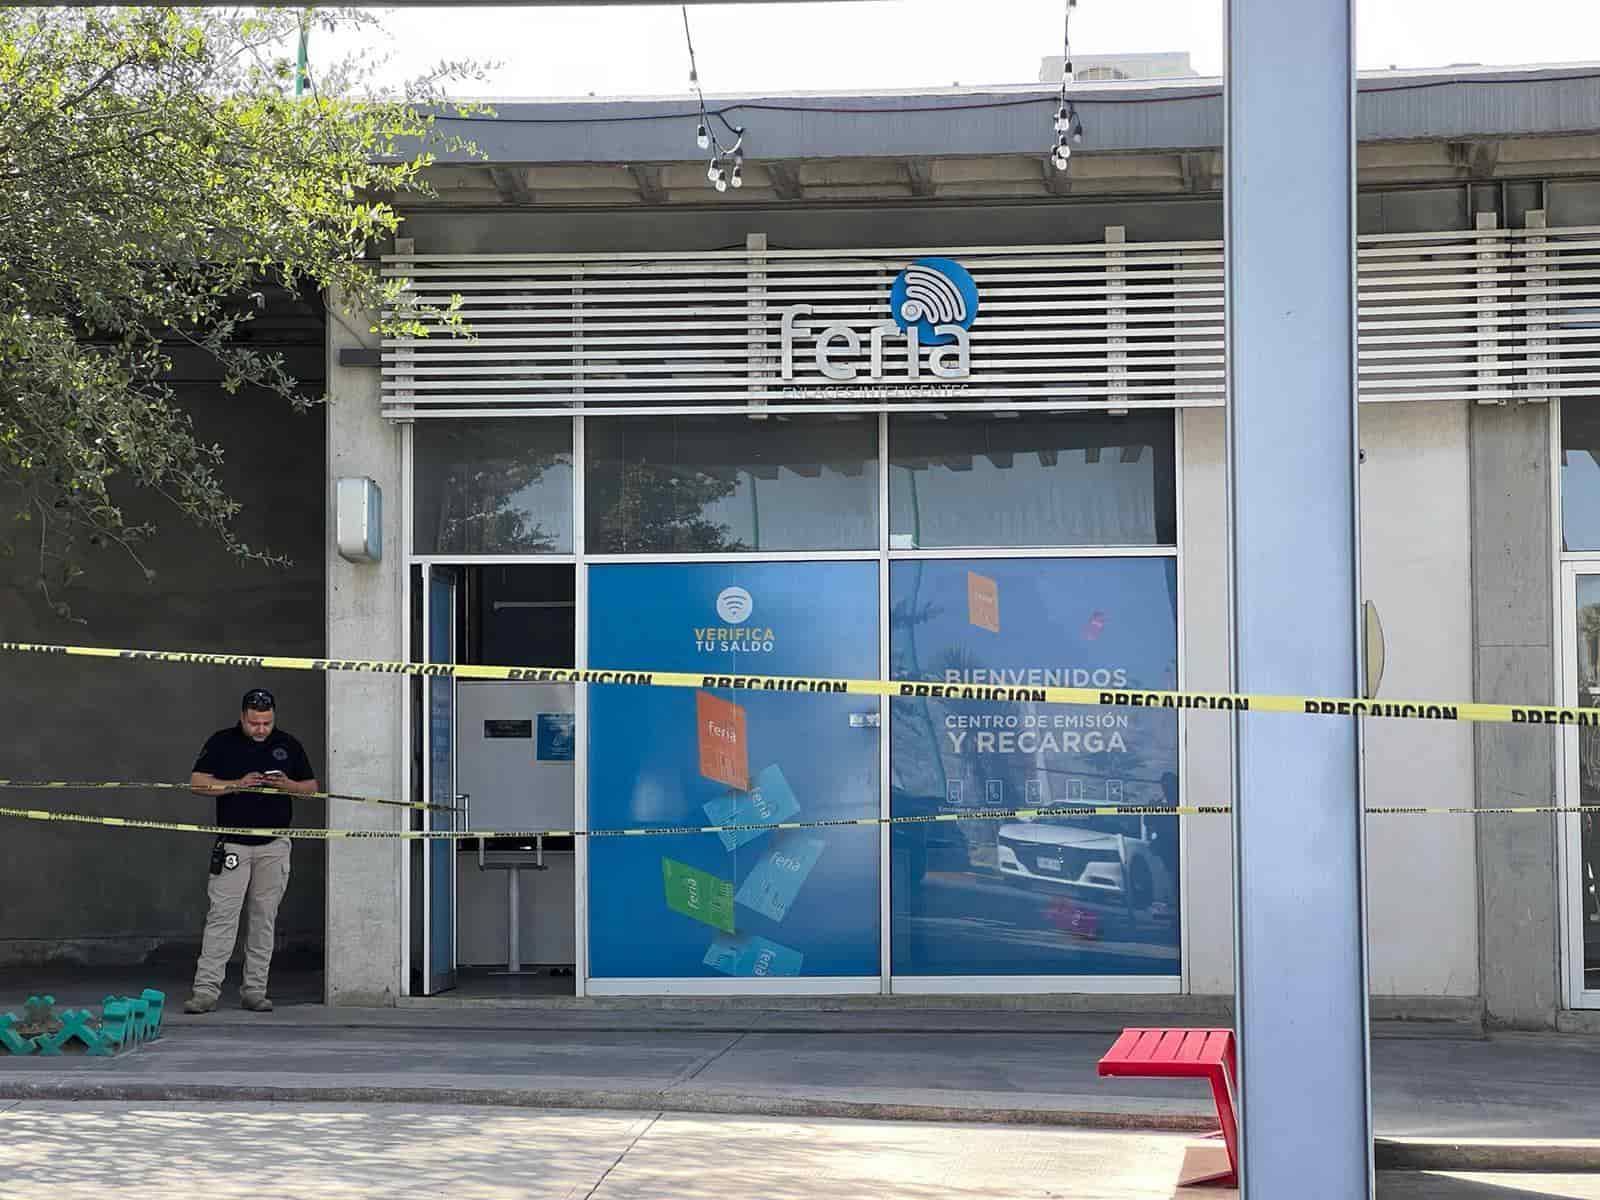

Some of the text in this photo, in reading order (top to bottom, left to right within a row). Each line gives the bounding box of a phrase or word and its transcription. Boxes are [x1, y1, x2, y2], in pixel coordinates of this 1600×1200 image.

[781, 303, 970, 380] feria
[695, 628, 775, 641] VERIFICA
[696, 641, 774, 652] TU SALDO
[945, 669, 1127, 687] BIENVENIDOS
[945, 712, 1128, 729] CENTRO DE EMISIÓN
[948, 732, 1127, 753] Y RECARGA
